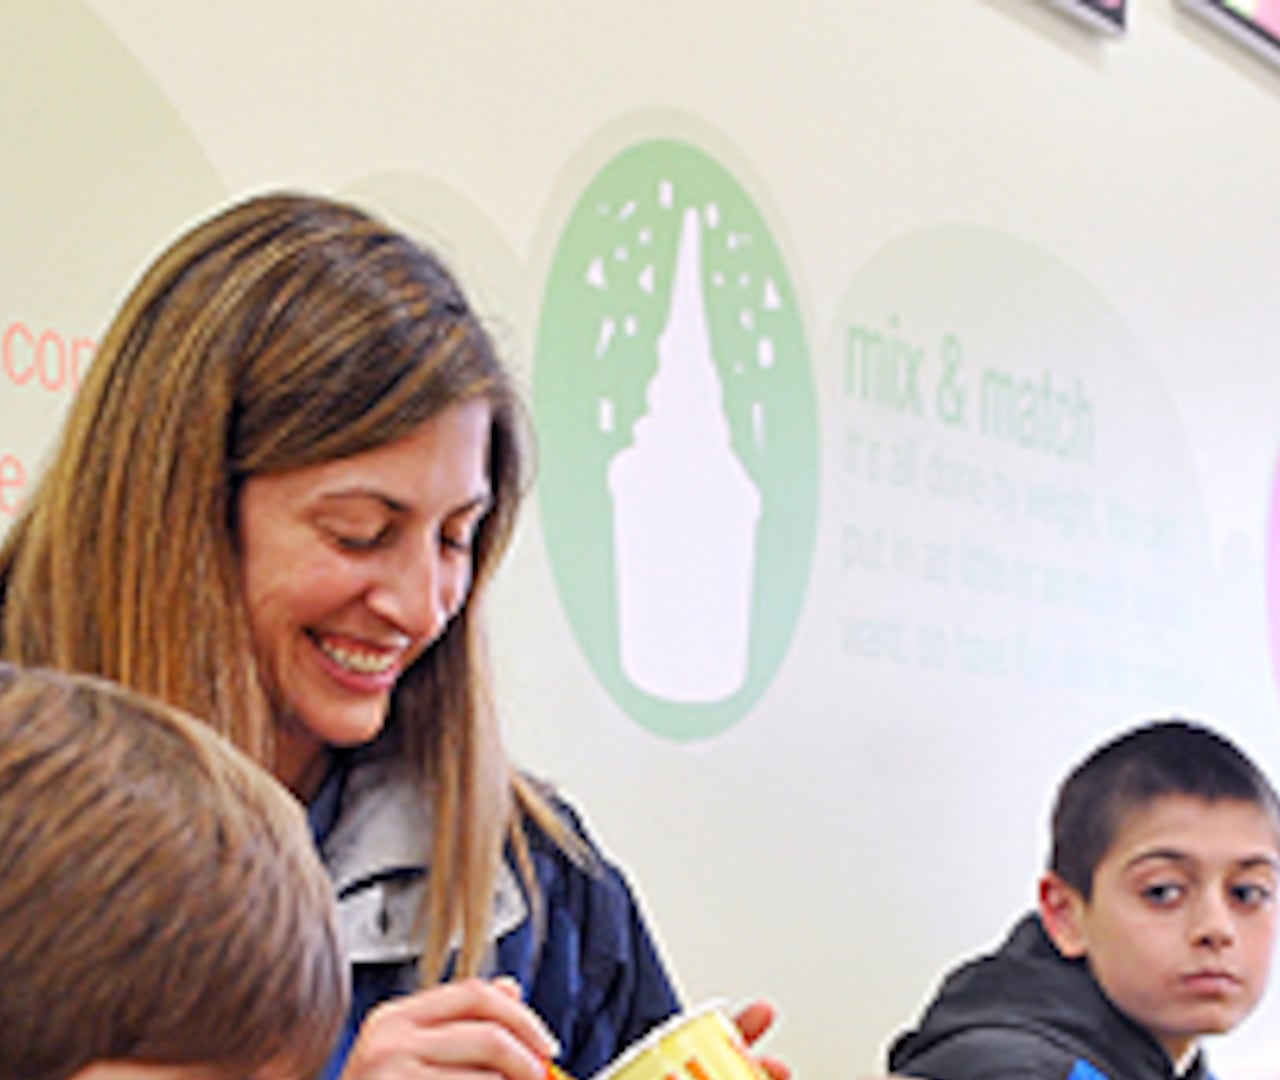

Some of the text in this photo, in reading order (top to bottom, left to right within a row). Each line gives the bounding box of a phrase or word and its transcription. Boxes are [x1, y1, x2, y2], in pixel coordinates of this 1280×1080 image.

[845, 314, 1096, 460] mix & match
